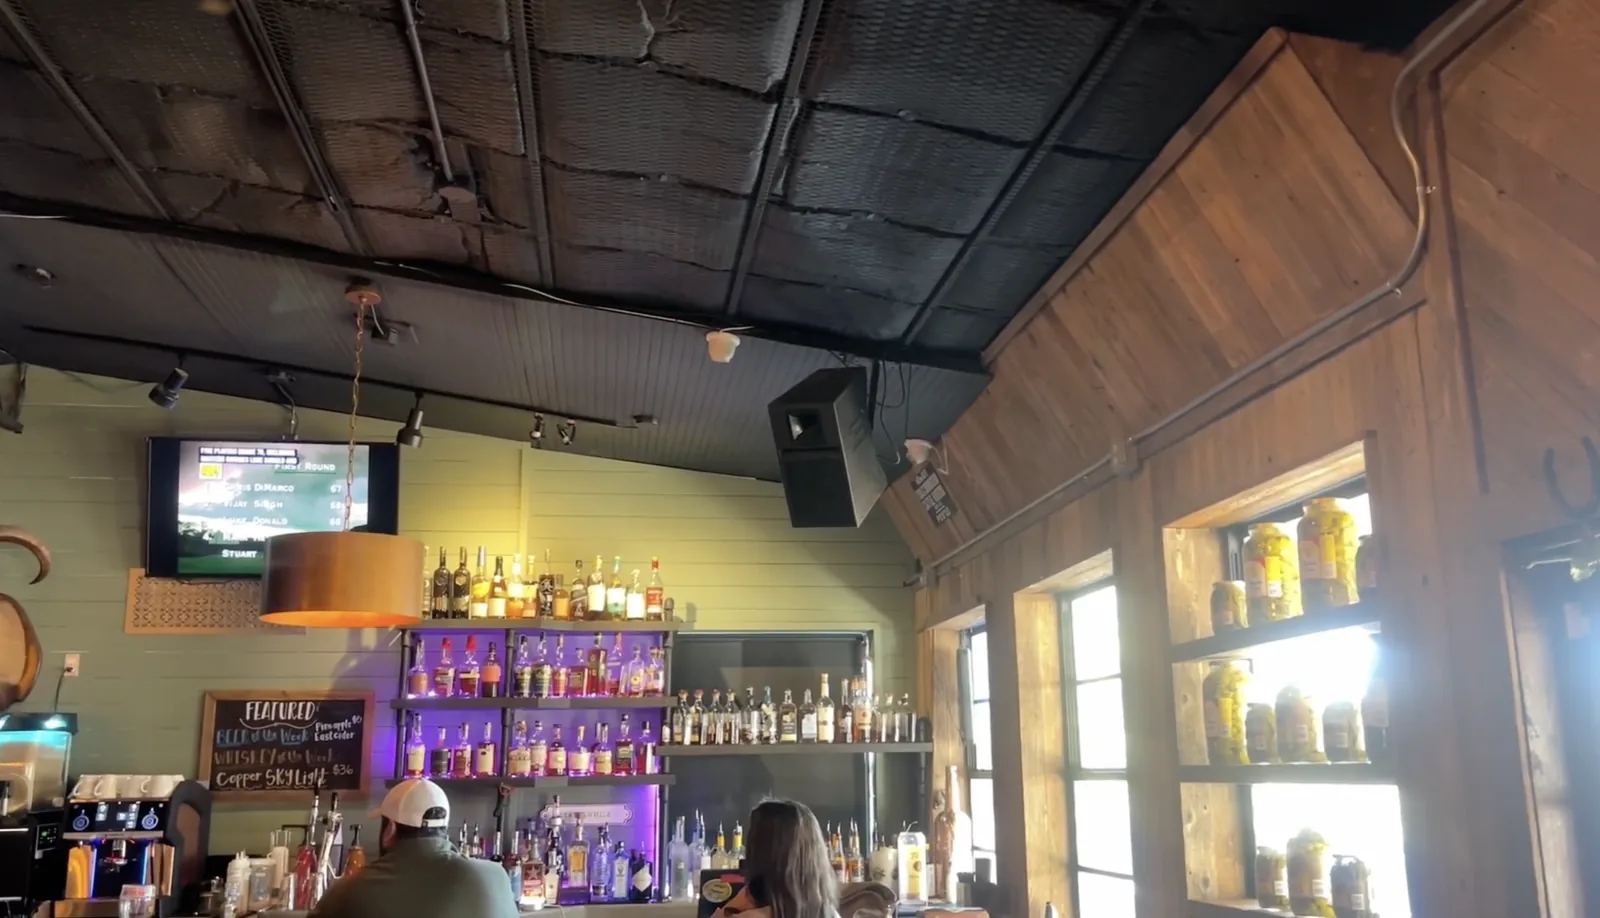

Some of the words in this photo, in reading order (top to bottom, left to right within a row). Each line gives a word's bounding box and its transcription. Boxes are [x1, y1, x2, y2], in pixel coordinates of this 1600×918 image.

[224, 483, 252, 493] CRIS
[330, 484, 342, 494] 67
[222, 548, 257, 559] STUART
[216, 771, 262, 788] Copper
[332, 763, 354, 776] $36
